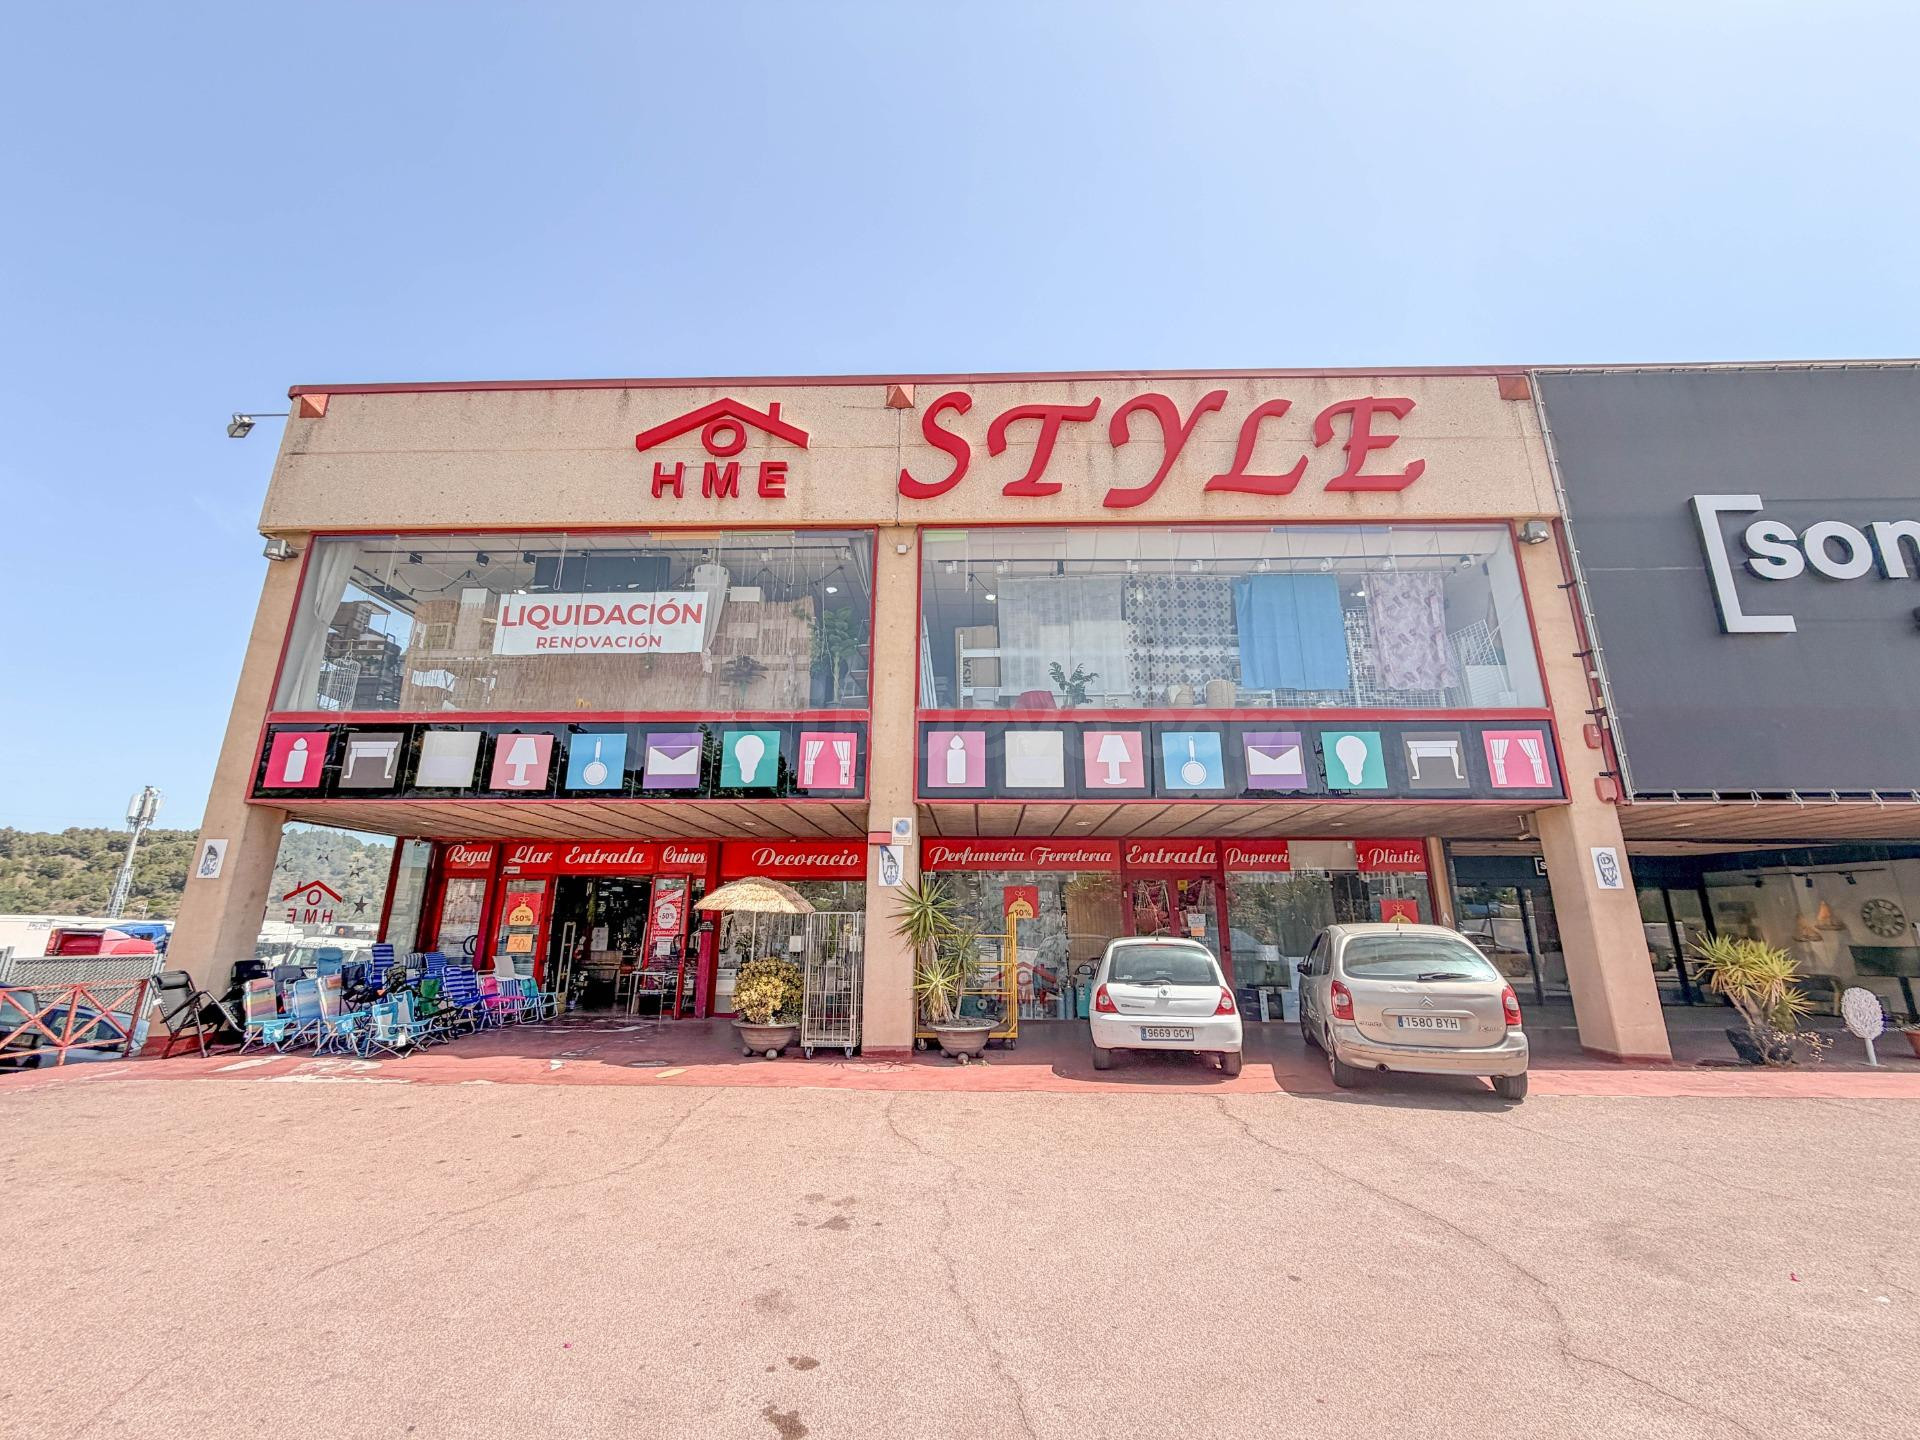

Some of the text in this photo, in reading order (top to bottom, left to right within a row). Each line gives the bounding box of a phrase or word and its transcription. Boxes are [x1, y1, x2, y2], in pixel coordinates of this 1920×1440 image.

[897, 389, 1426, 509] STYLE
[501, 597, 703, 631] LIQUIDACIÓN
[536, 632, 663, 649] RENOVACIÓN
[507, 845, 553, 864] Llar
[564, 845, 645, 864] Entrada
[662, 845, 708, 864] Cuines
[928, 846, 1112, 865] Perfumeria Ferreteria
[1125, 845, 1218, 864] Entrada
[1225, 847, 1290, 866] Papereri
[1405, 1016, 1459, 1030] 1580 BYH
[1147, 1027, 1191, 1039] 9669 GCY
